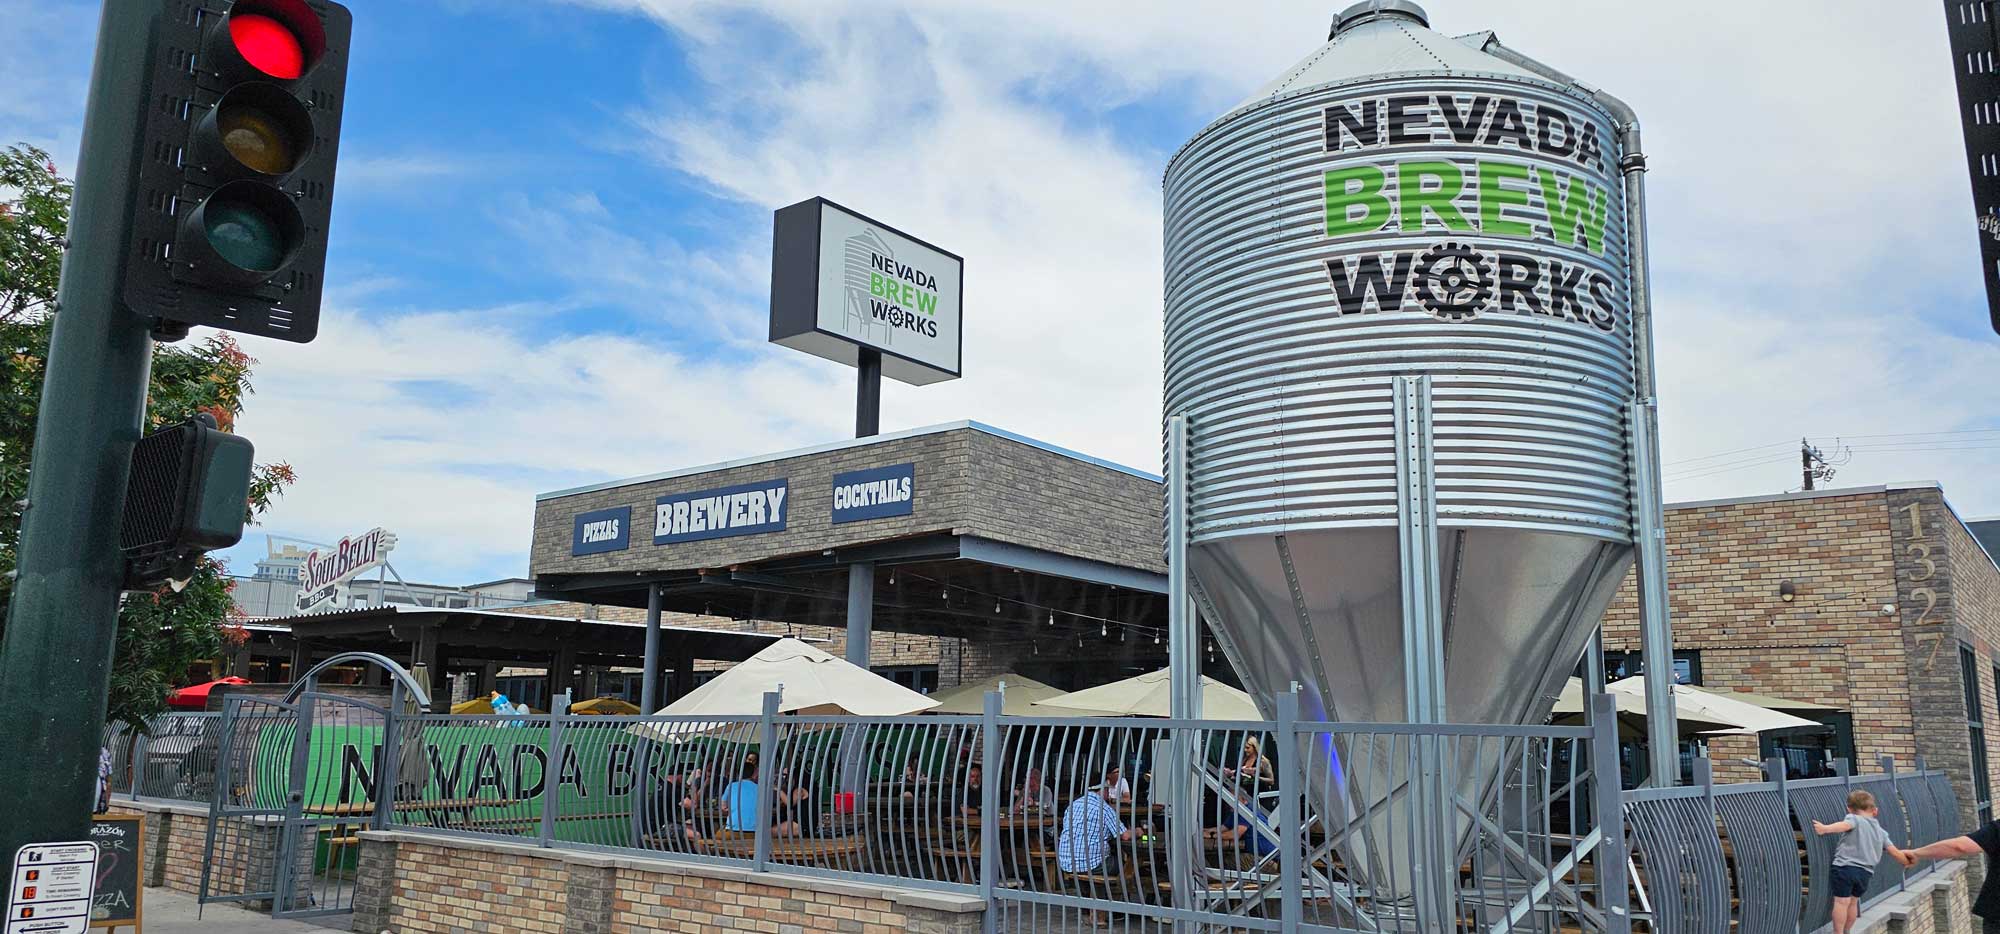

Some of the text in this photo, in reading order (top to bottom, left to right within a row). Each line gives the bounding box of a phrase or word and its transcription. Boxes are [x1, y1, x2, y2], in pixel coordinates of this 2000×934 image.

[1323, 94, 1608, 178] NEVADA
[1323, 159, 1609, 257] BREW
[870, 271, 938, 317] BREW
[871, 252, 938, 293] NEVADA
[1323, 240, 1616, 333] WORKS
[870, 298, 938, 339] WORKS
[654, 486, 786, 538] BREWERY
[833, 475, 912, 511] COCKTAILS
[582, 518, 619, 544] PIZZAS
[309, 590, 326, 606] BBQ
[1900, 502, 1945, 672] 1327
[337, 743, 589, 803] NVADA
[94, 889, 130, 909] ZZA
